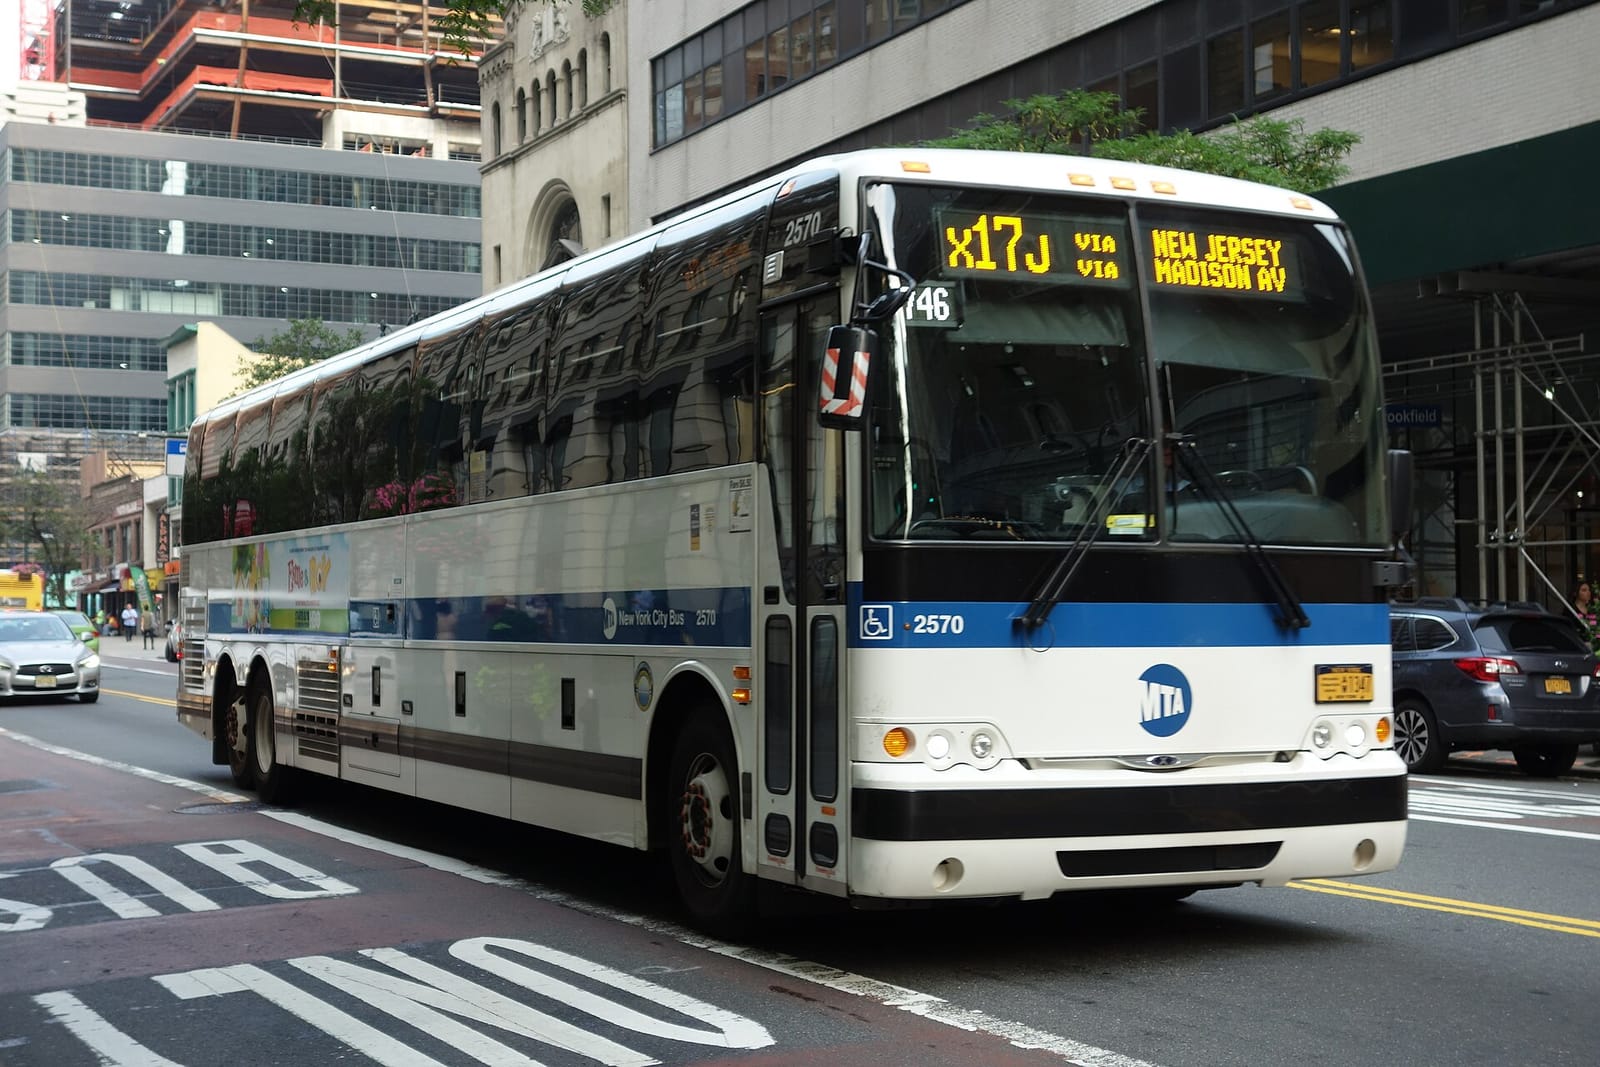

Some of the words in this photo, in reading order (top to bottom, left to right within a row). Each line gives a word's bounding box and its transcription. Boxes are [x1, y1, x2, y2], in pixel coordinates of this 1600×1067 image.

[784, 212, 821, 247] 2570
[1074, 232, 1117, 254] VIA
[1152, 229, 1197, 260] NEW
[1204, 234, 1282, 267] JERSEY
[1076, 258, 1119, 280] VIA
[1153, 257, 1252, 290] MADISON
[1256, 266, 1287, 293] AV
[1387, 409, 1437, 423] ookfield
[618, 609, 634, 626] New
[635, 609, 652, 626] York
[652, 609, 669, 628] City
[669, 609, 684, 626] Bus
[695, 609, 716, 626] 2570
[913, 614, 965, 634] 2570
[1137, 679, 1185, 723] MTA
